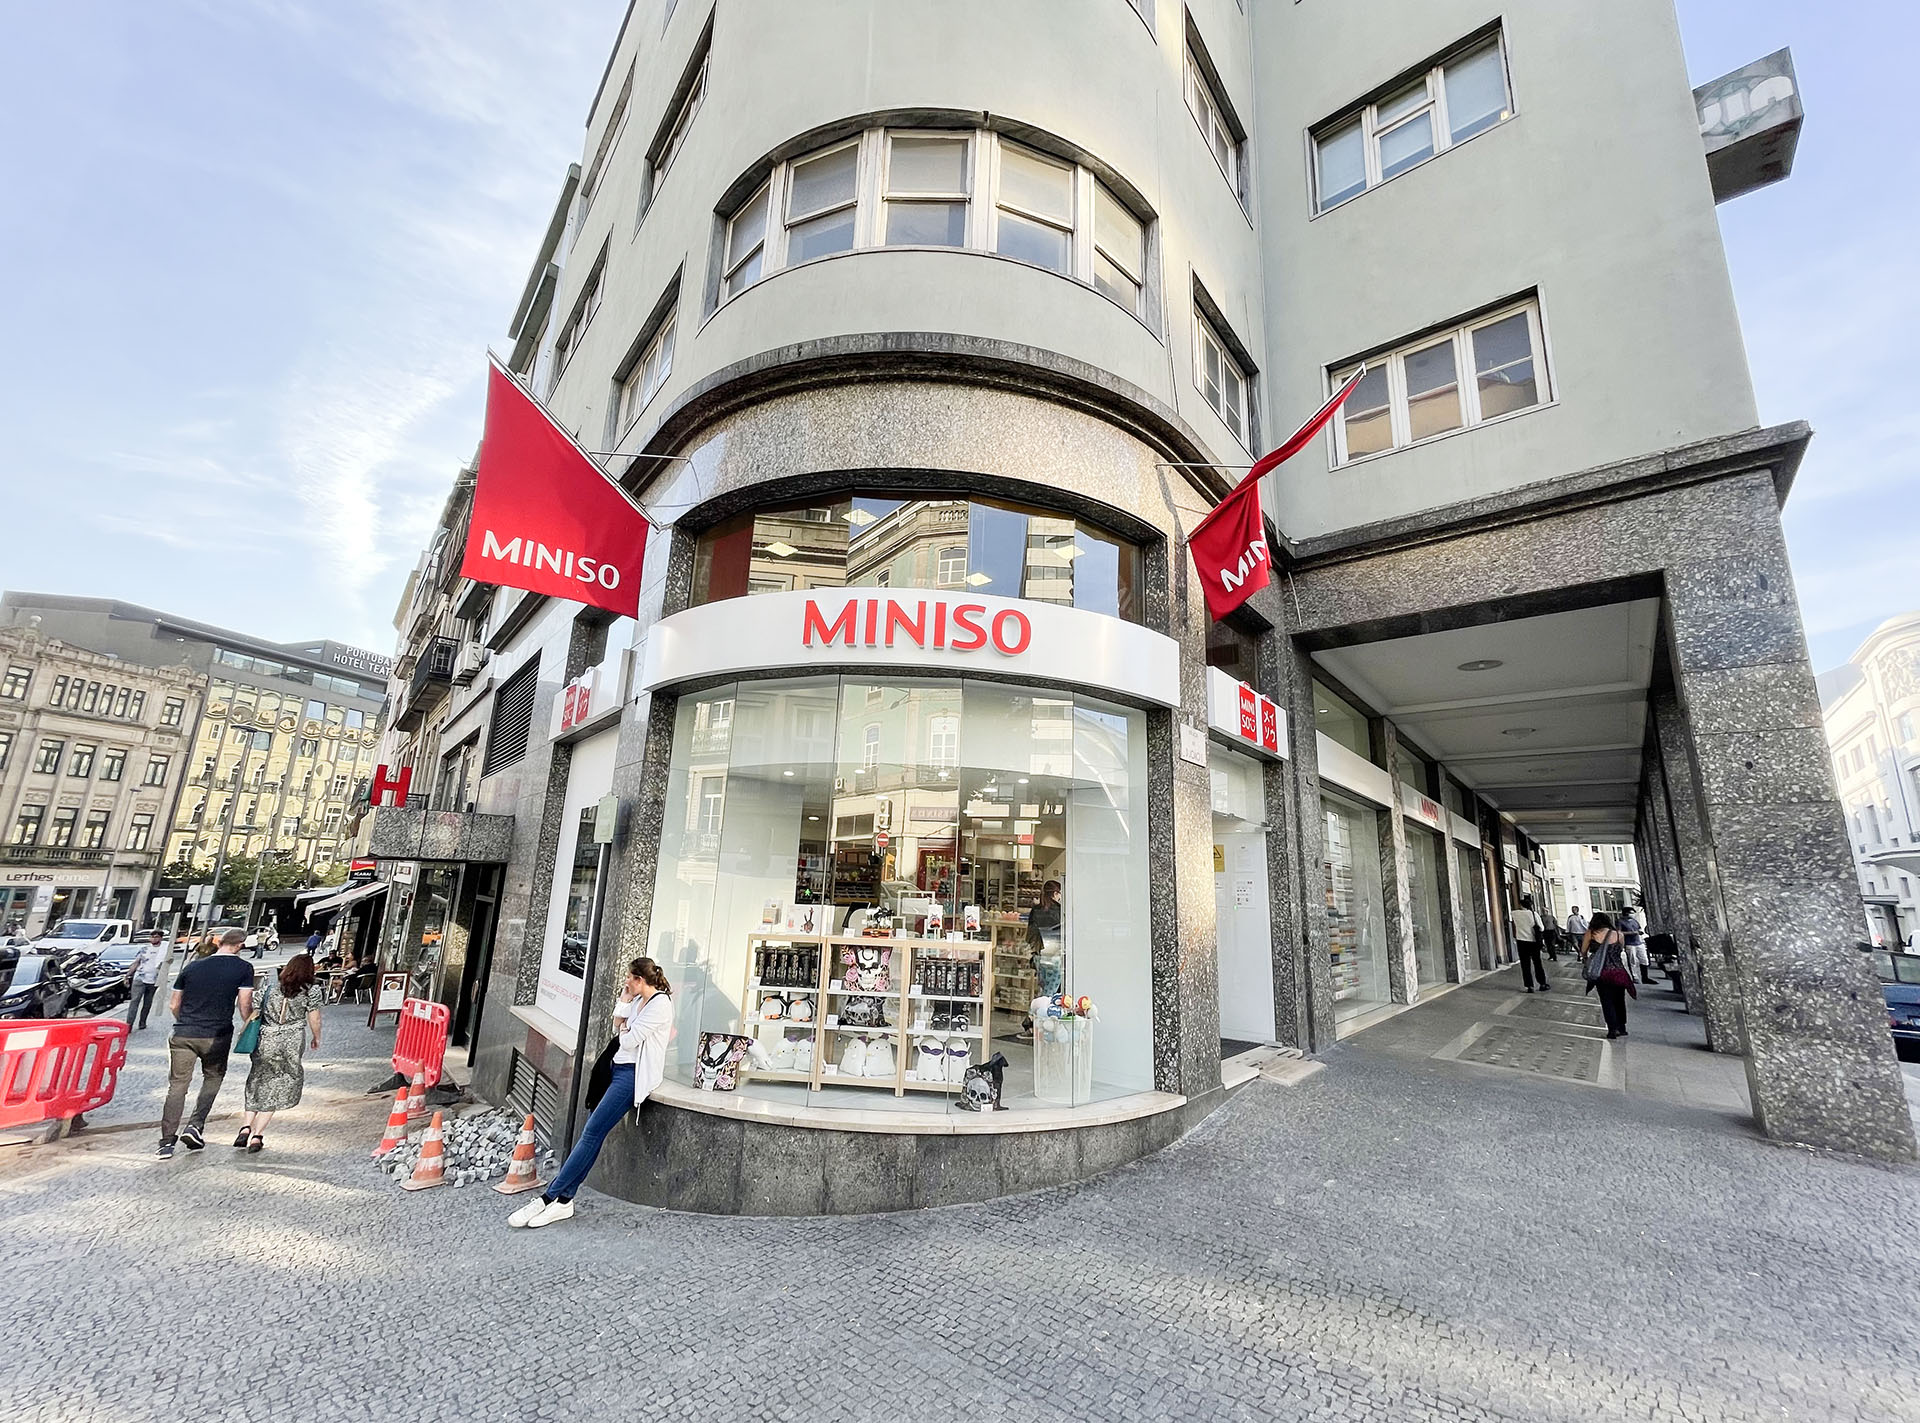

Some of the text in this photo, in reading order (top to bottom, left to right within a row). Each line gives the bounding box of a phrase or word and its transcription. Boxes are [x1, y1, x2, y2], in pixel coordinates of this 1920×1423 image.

[481, 529, 620, 590] MINISO
[802, 598, 1033, 658] MINISO
[333, 653, 365, 670] HOTEL
[1240, 696, 1255, 716] MINI
[371, 764, 412, 808] H
